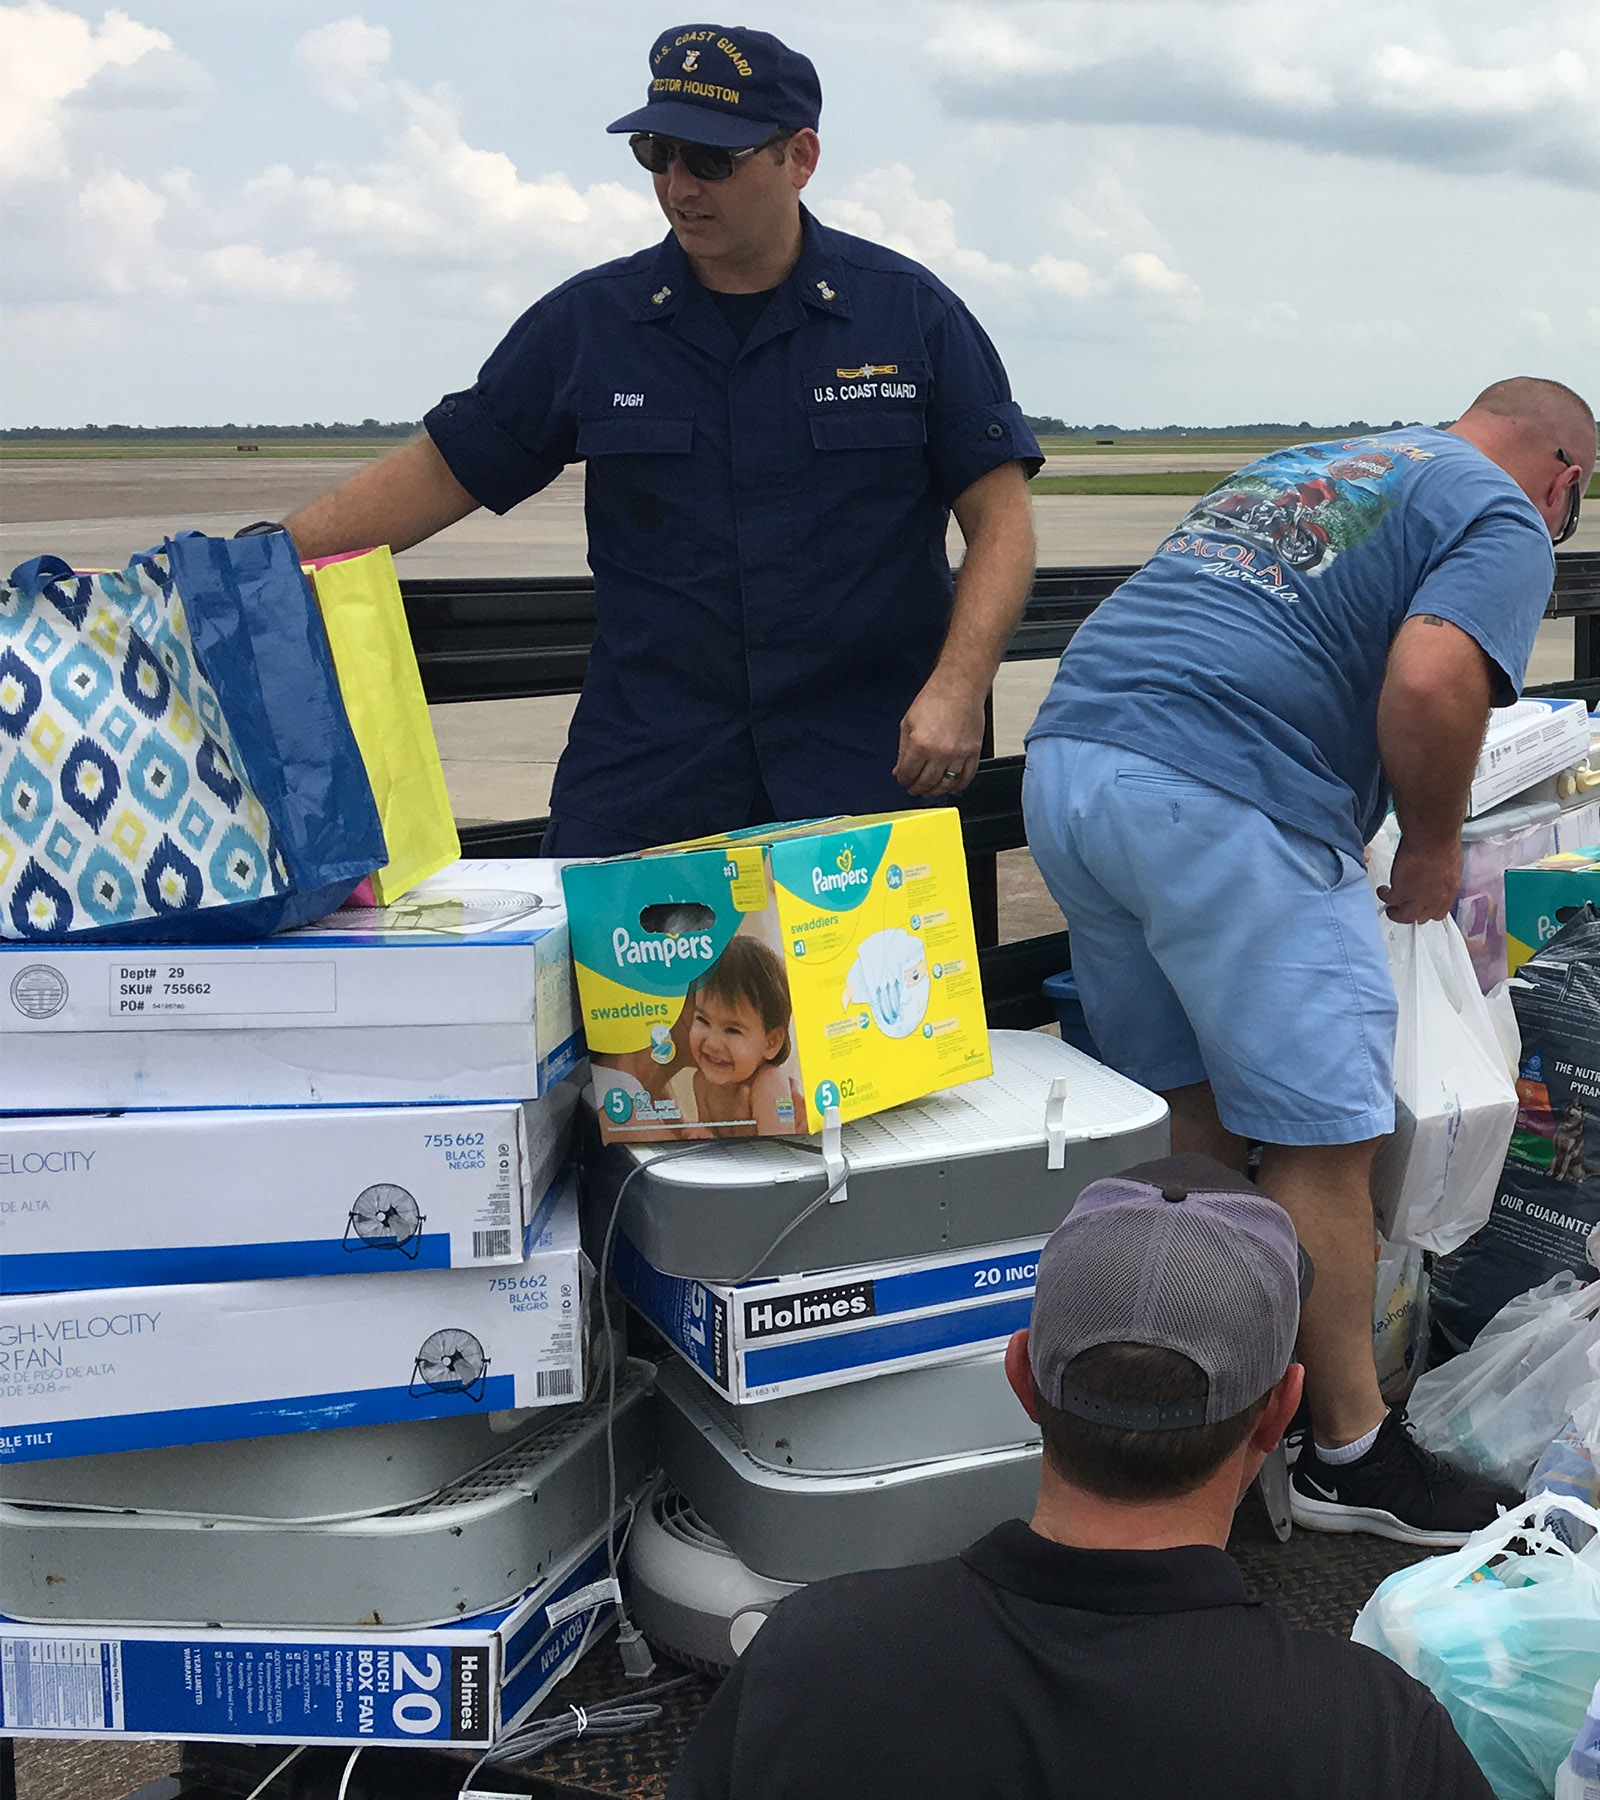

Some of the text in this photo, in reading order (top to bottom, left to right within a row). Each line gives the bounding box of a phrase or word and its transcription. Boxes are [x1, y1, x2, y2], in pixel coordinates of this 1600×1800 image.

[654, 31, 753, 77] U.S. COAST GUARD
[683, 81, 739, 104] HOUSTON
[613, 393, 644, 407] PUGH
[814, 383, 916, 403] U.S. COAST GUARD
[1195, 562, 1300, 603] Florida
[723, 863, 736, 877] #1
[812, 867, 868, 895] Pampers
[791, 916, 839, 934] swaddlers
[613, 927, 713, 967] Pampers
[120, 967, 185, 980] Dept# 29
[120, 983, 211, 996] SKU# 755662
[120, 1001, 145, 1012] PO#
[591, 1002, 668, 1020] swaddlers
[1554, 1061, 1573, 1076] THE
[612, 1092, 624, 1114] 5
[634, 1091, 651, 1111] 62
[821, 1083, 833, 1107] 5
[840, 1078, 855, 1099] 62
[445, 1149, 485, 1162] BLACK
[449, 1160, 486, 1170] NEGRO
[1, 1200, 50, 1213] DE ALTA
[1500, 1194, 1523, 1213] OUR
[974, 1267, 1002, 1288] 20
[509, 1291, 549, 1304] BLACK
[513, 1302, 549, 1312] NEGRO
[691, 1282, 707, 1347] 51
[751, 1295, 867, 1333] Holmes
[713, 1303, 723, 1378] Holmes
[14, 1346, 63, 1370] FAN
[14, 1363, 116, 1384] DE PISO DE ALTA
[7, 1385, 24, 1397] DE
[772, 1384, 780, 1394] W
[25, 1432, 54, 1446] TILT
[541, 1639, 560, 1673] FAN
[184, 1648, 192, 1690] WARRANTY
[377, 1651, 389, 1693] INCH
[194, 1654, 203, 1706] YEAR LIMITED
[334, 1651, 343, 1723] Comparison Chart
[358, 1650, 374, 1733] BOX FAN
[392, 1651, 442, 1734] 20
[461, 1655, 478, 1731] Holmes
